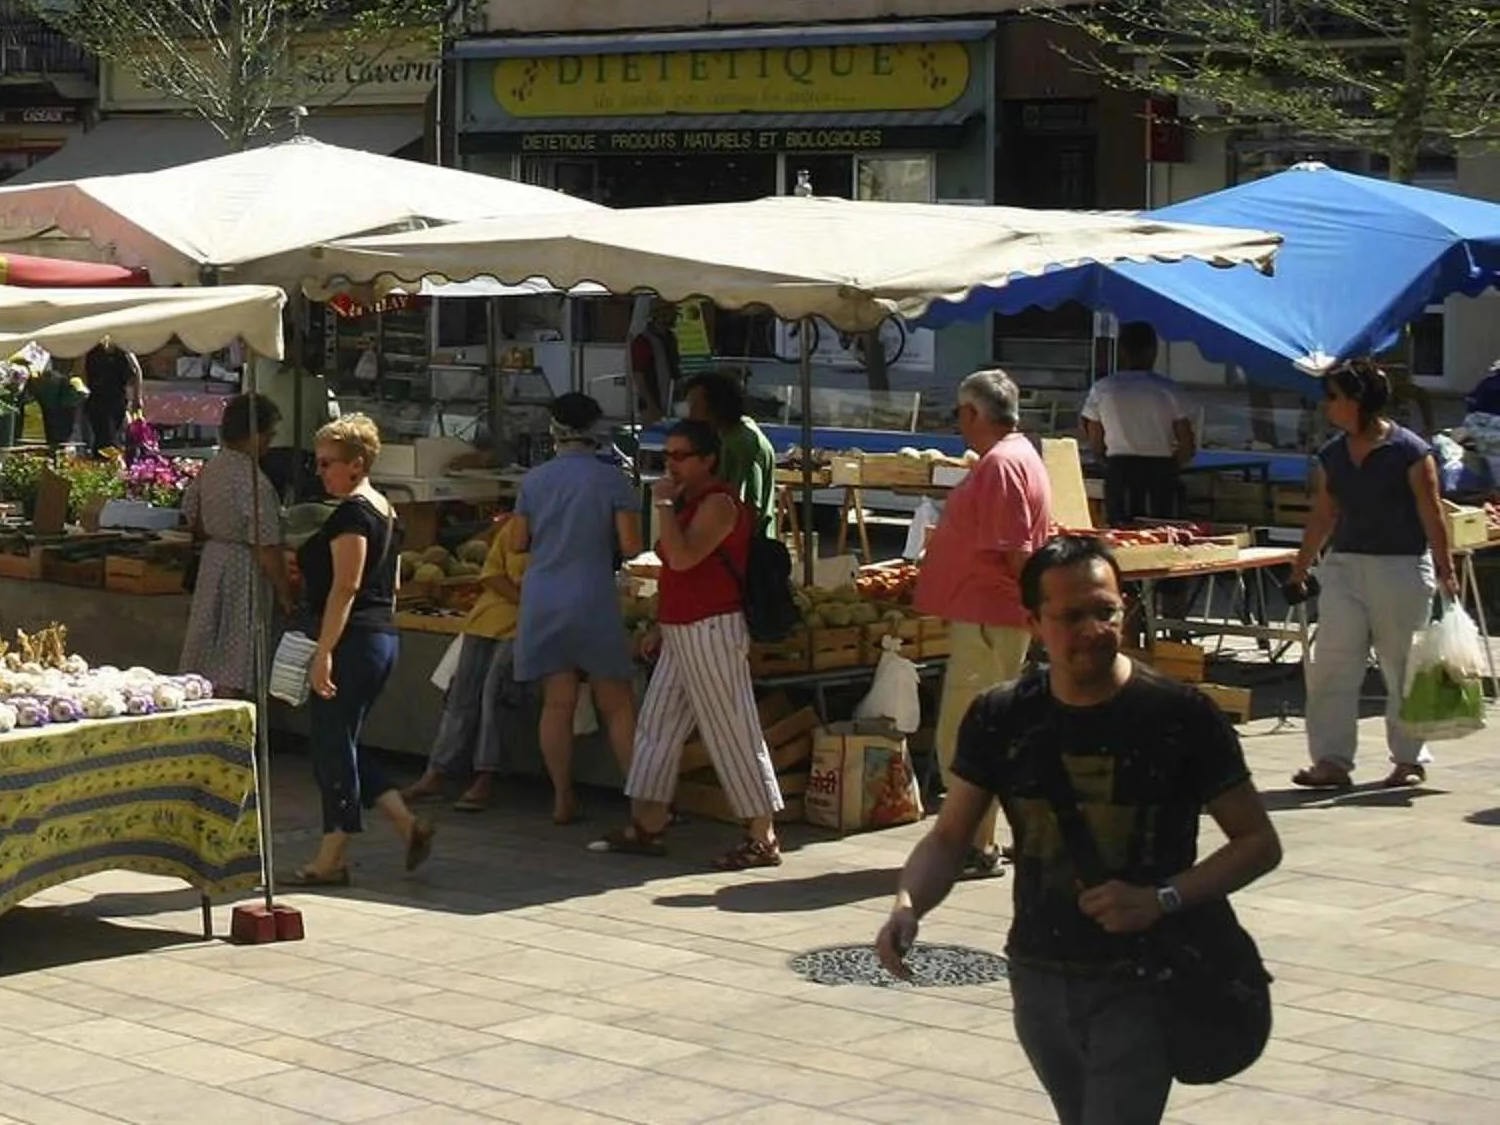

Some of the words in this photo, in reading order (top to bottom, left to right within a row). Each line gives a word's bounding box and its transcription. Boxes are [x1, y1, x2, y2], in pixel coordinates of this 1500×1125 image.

[345, 51, 437, 84] Cavern
[611, 133, 676, 150] PRODUITS
[684, 132, 750, 148] NATURELS
[759, 131, 777, 148] ET
[786, 130, 882, 147] BIOLOGIQUES
